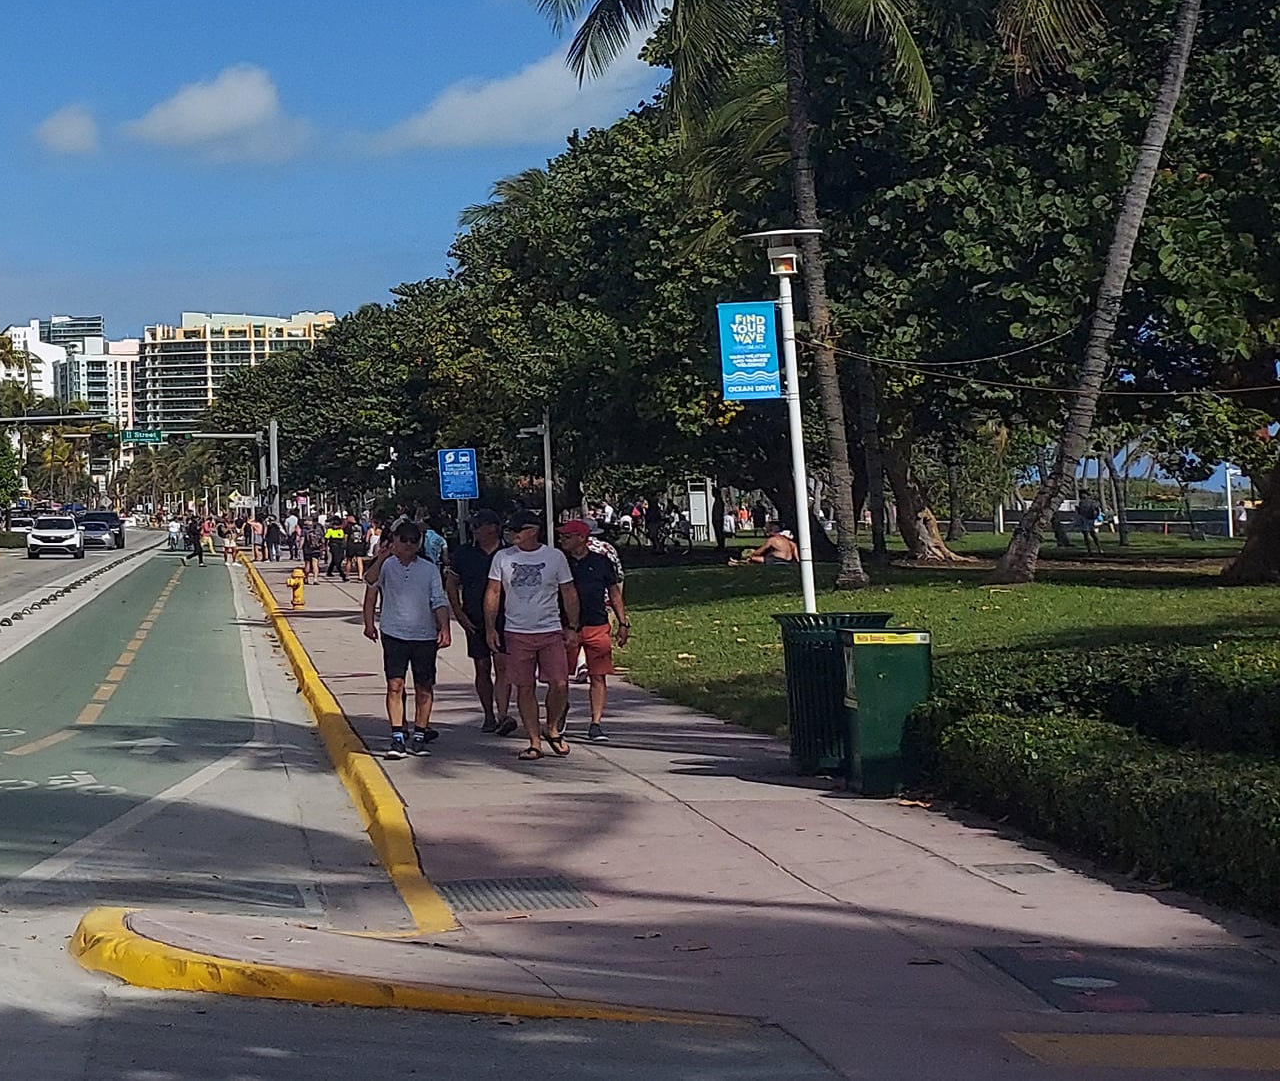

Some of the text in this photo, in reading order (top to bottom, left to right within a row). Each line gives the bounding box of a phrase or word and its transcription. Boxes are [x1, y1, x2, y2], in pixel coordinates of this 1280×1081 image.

[735, 314, 766, 325] FIND
[730, 323, 766, 334] YOUR
[733, 332, 764, 344] WAVE
[728, 384, 777, 393] OCEAN DRIVE
